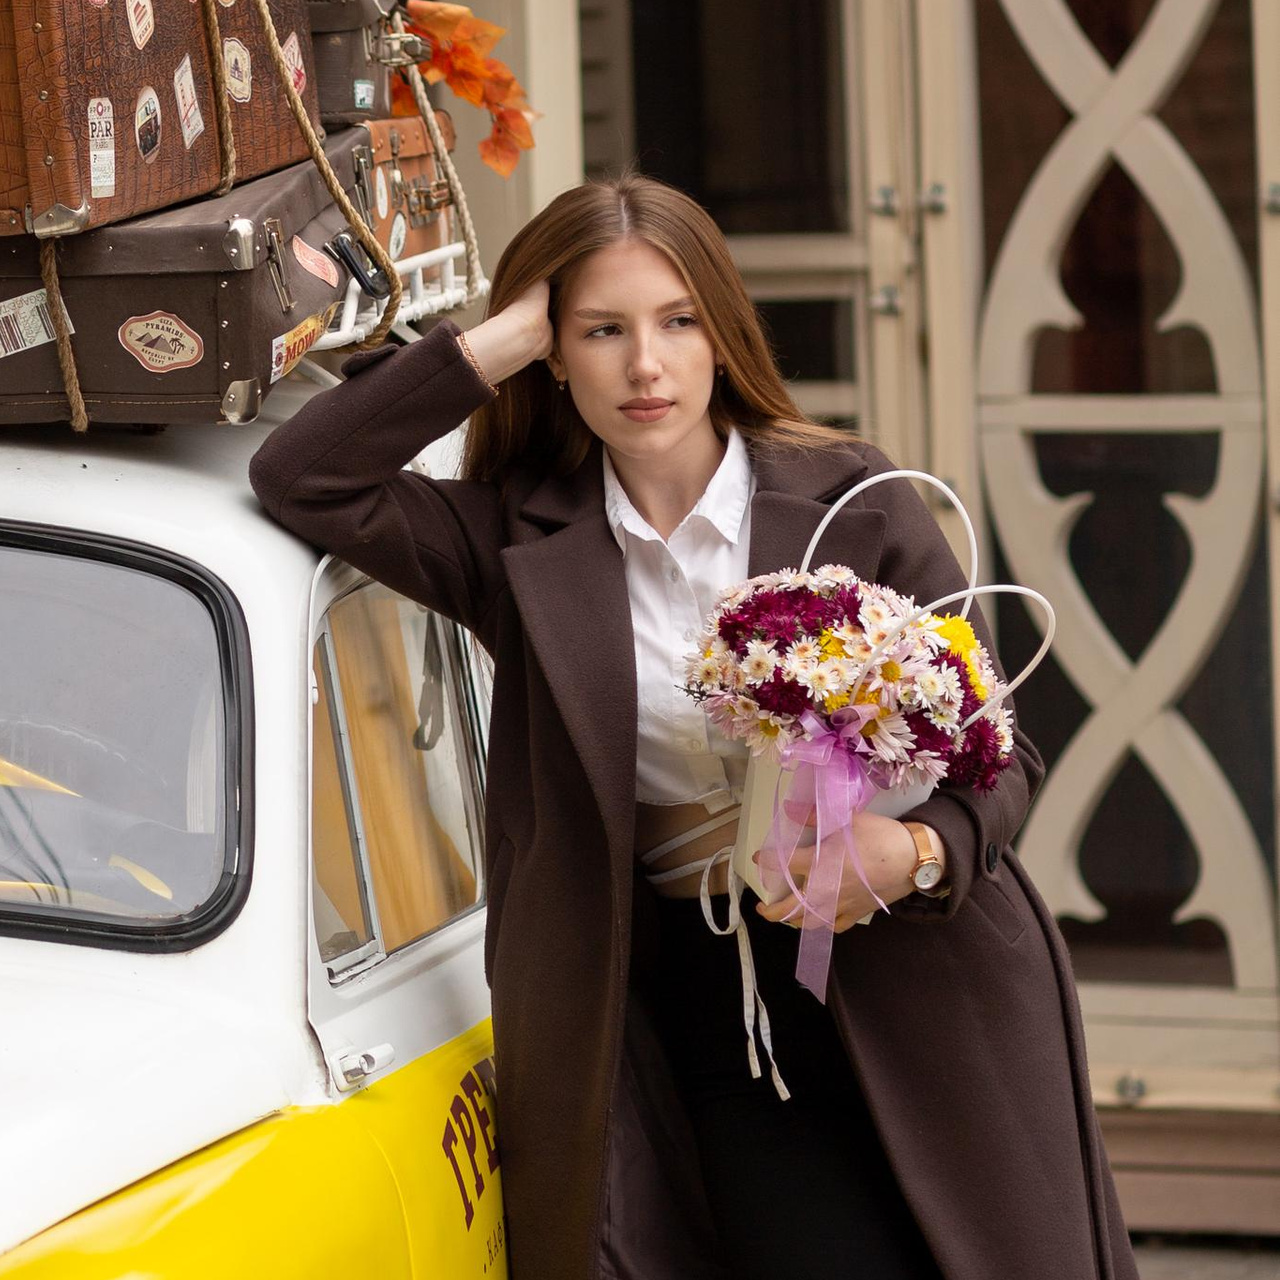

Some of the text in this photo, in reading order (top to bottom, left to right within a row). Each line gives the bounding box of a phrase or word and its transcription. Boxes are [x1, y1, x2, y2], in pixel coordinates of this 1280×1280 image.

[90, 121, 112, 138] PAR
[145, 323, 184, 338] PYRAMIDS
[284, 328, 316, 366] MOW
